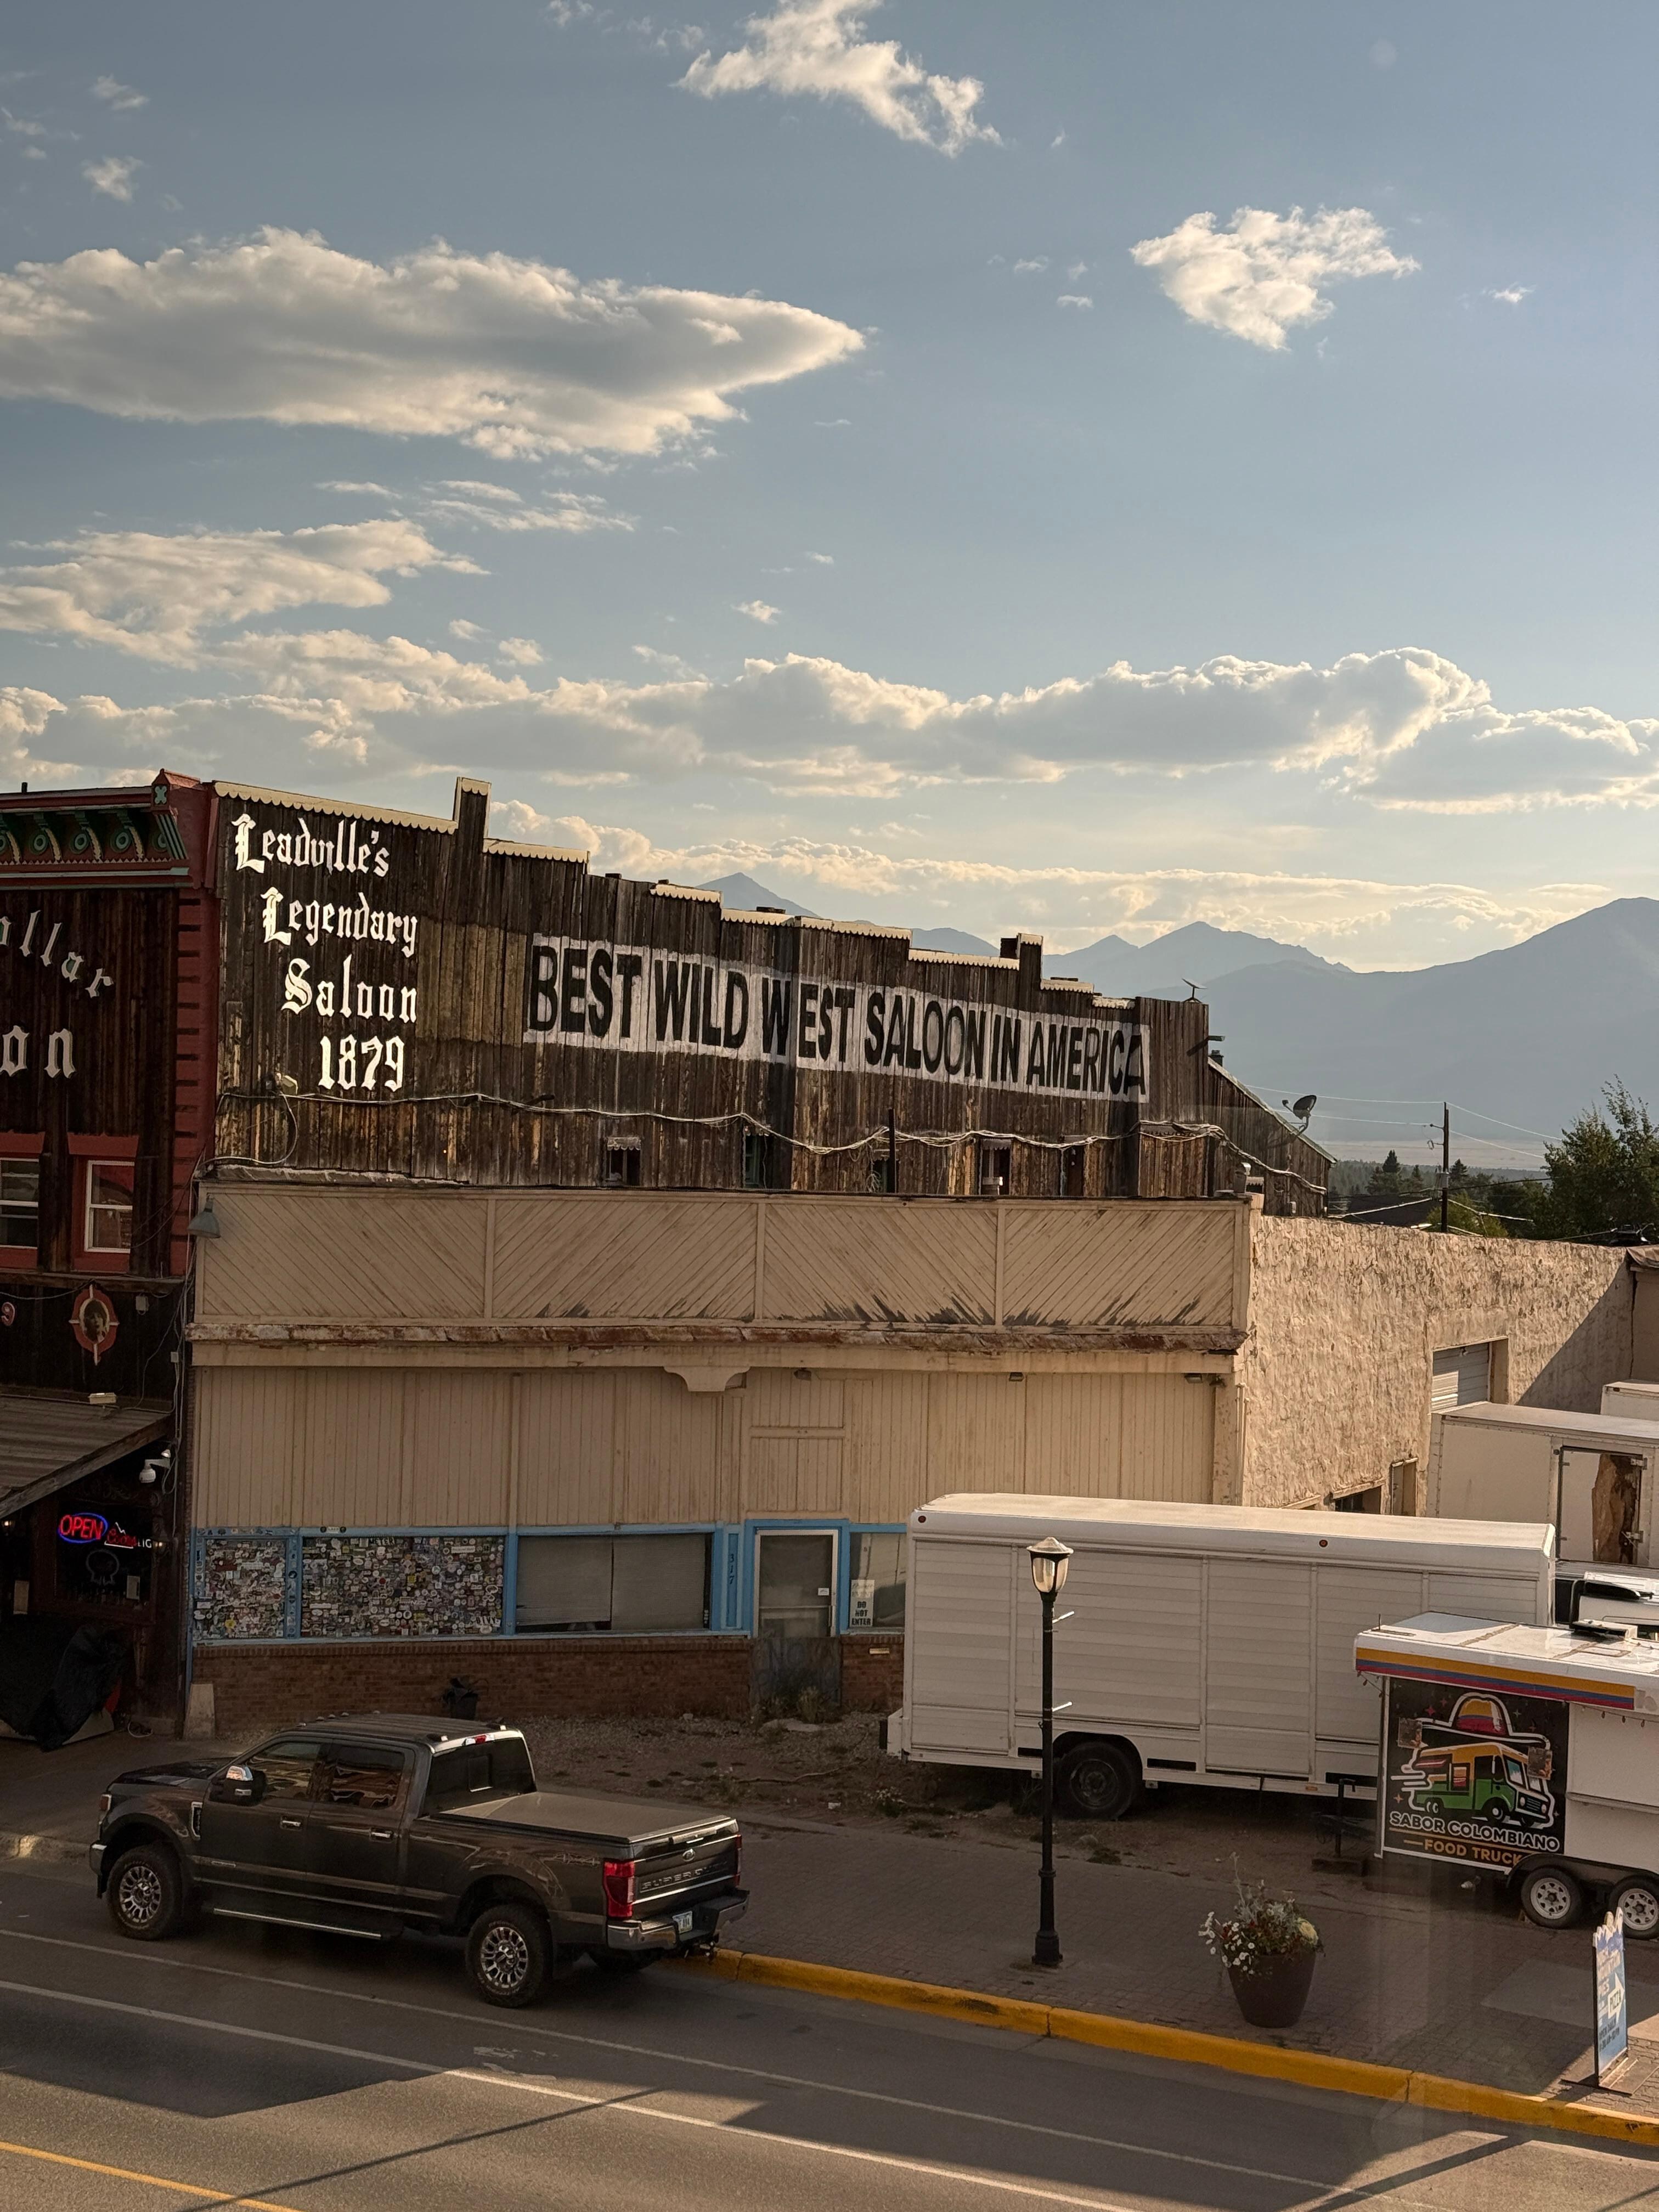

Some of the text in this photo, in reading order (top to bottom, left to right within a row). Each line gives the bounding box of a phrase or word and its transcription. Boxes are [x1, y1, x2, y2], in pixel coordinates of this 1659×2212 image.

[232, 813, 390, 877] Leadville's
[260, 886, 417, 958] Legendary
[280, 953, 417, 1024] Saloon
[529, 944, 1146, 1096] BEST WILD WEST SALOON IN AMERICA
[318, 1034, 405, 1092] 1879
[60, 1514, 103, 1541] OPEN
[138, 1538, 152, 1549] LIG
[1389, 1810, 1559, 1852] SABOR COLOMBIANO
[1424, 1839, 1523, 1866] FOOD TRUCK
[642, 1871, 692, 1890] SUPER
